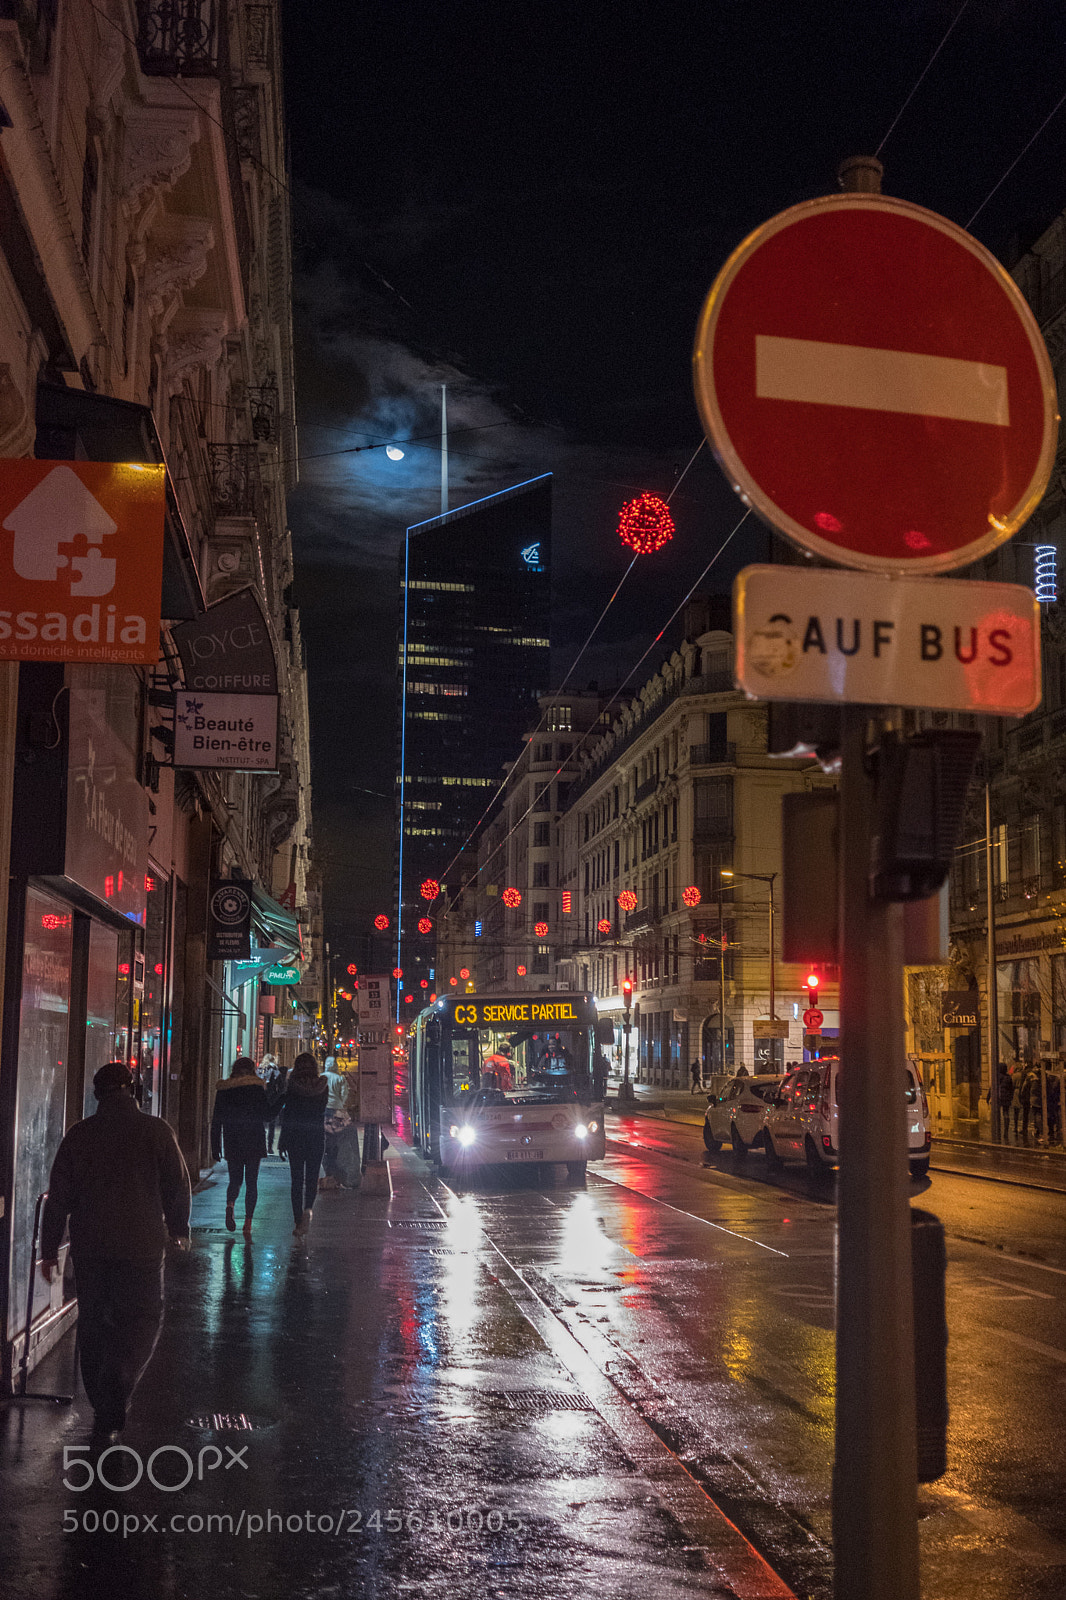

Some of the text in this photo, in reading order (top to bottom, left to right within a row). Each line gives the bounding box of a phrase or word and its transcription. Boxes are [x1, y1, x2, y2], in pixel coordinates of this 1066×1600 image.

[20, 644, 74, 657] domicile
[78, 646, 145, 661] intelligents
[187, 622, 264, 667] JOYCE
[920, 623, 1014, 666] BUS
[193, 674, 271, 689] COIFFURE
[194, 715, 254, 732] Beauté
[193, 735, 272, 752] Bien-être
[216, 756, 250, 765] INSTITUT
[255, 757, 269, 765] SPA
[268, 971, 286, 979] PMU
[454, 1003, 578, 1024] C3 SERVICE PARTIEL
